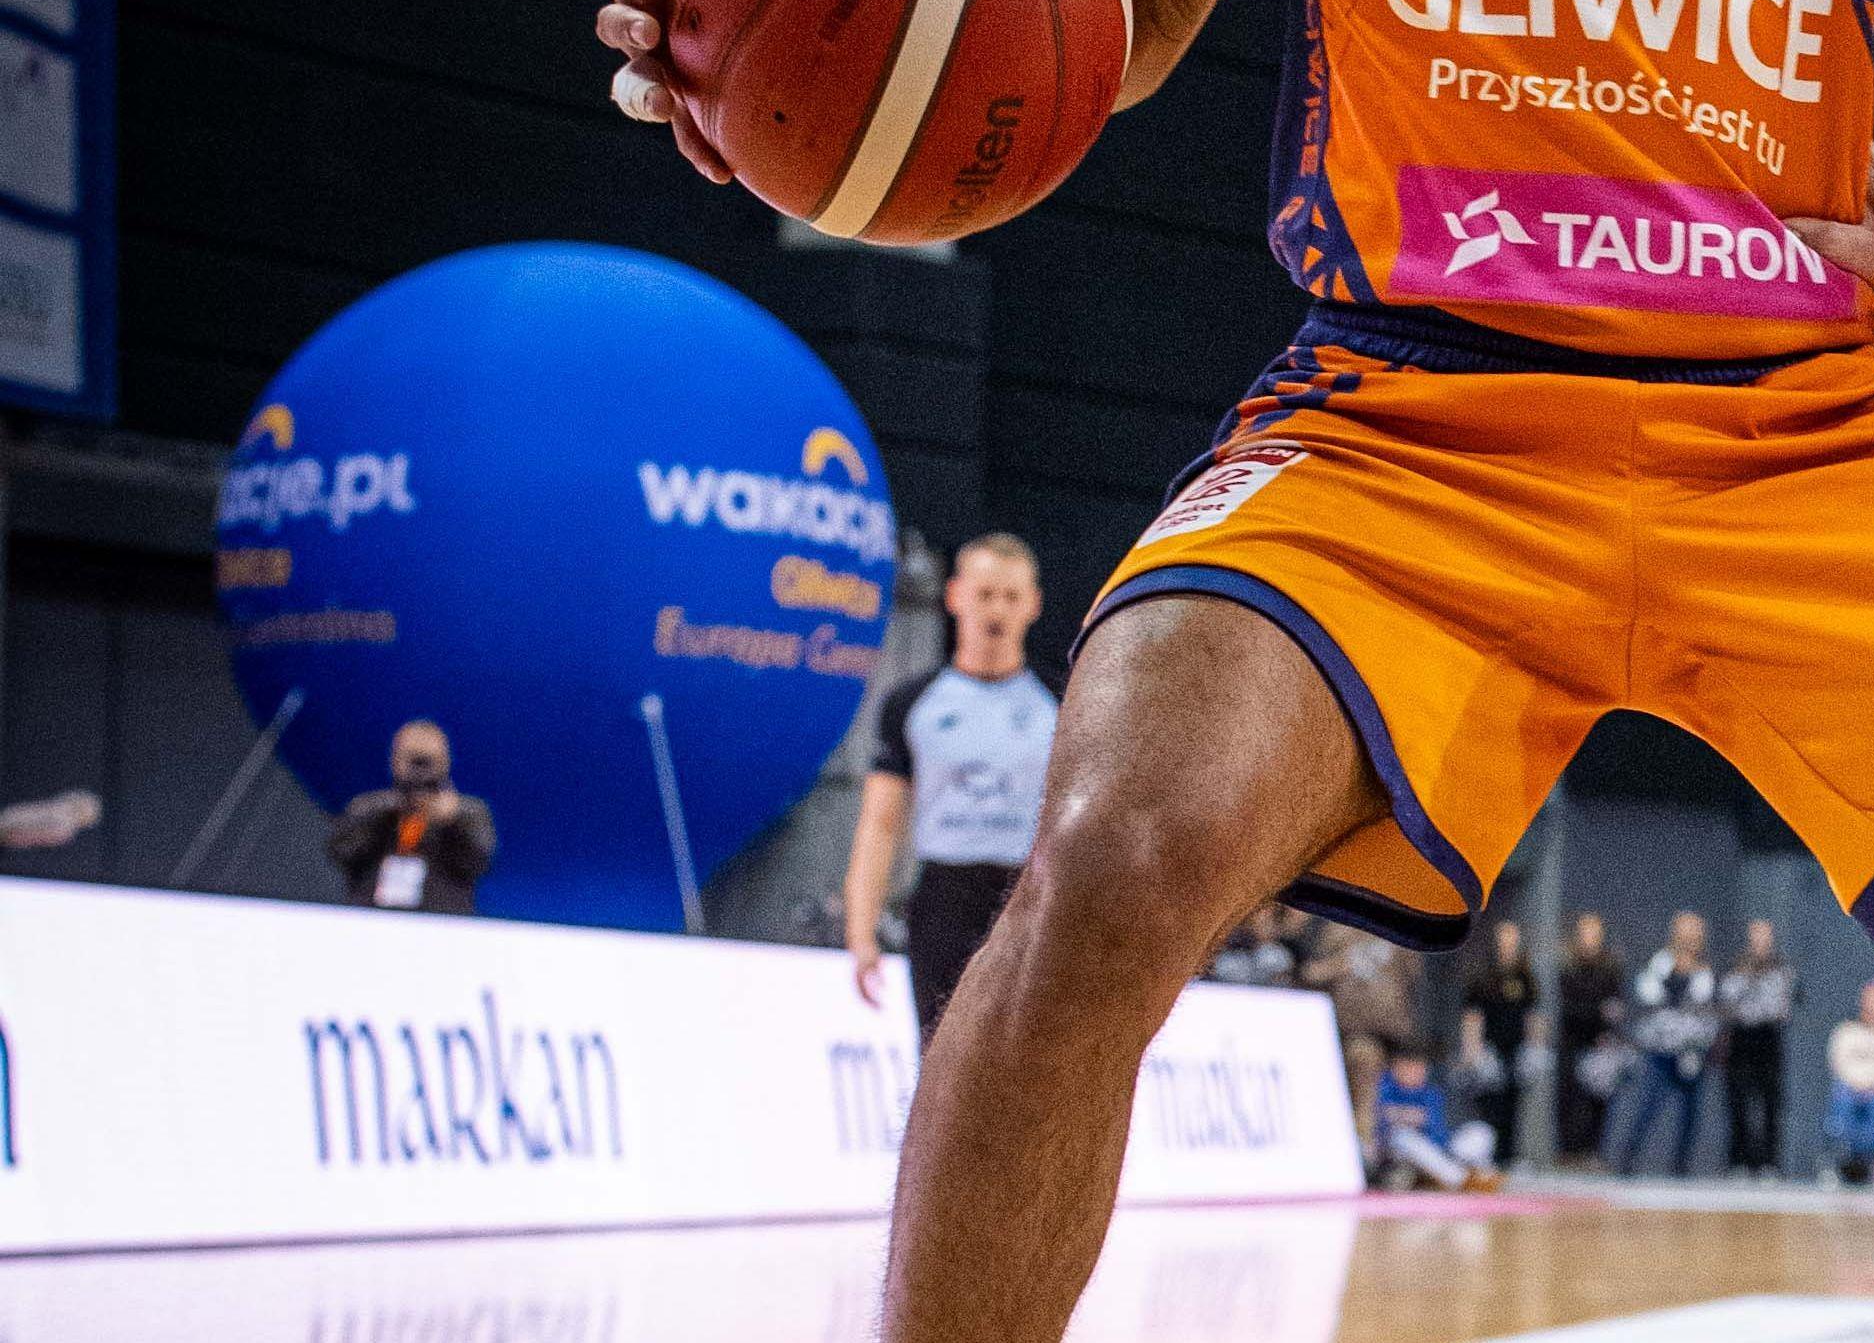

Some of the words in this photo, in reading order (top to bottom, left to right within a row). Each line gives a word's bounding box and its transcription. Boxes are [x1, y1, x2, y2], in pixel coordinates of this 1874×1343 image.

[1683, 86, 1754, 152] jest
[1756, 121, 1787, 177] tu
[1542, 212, 1827, 285] TAURON
